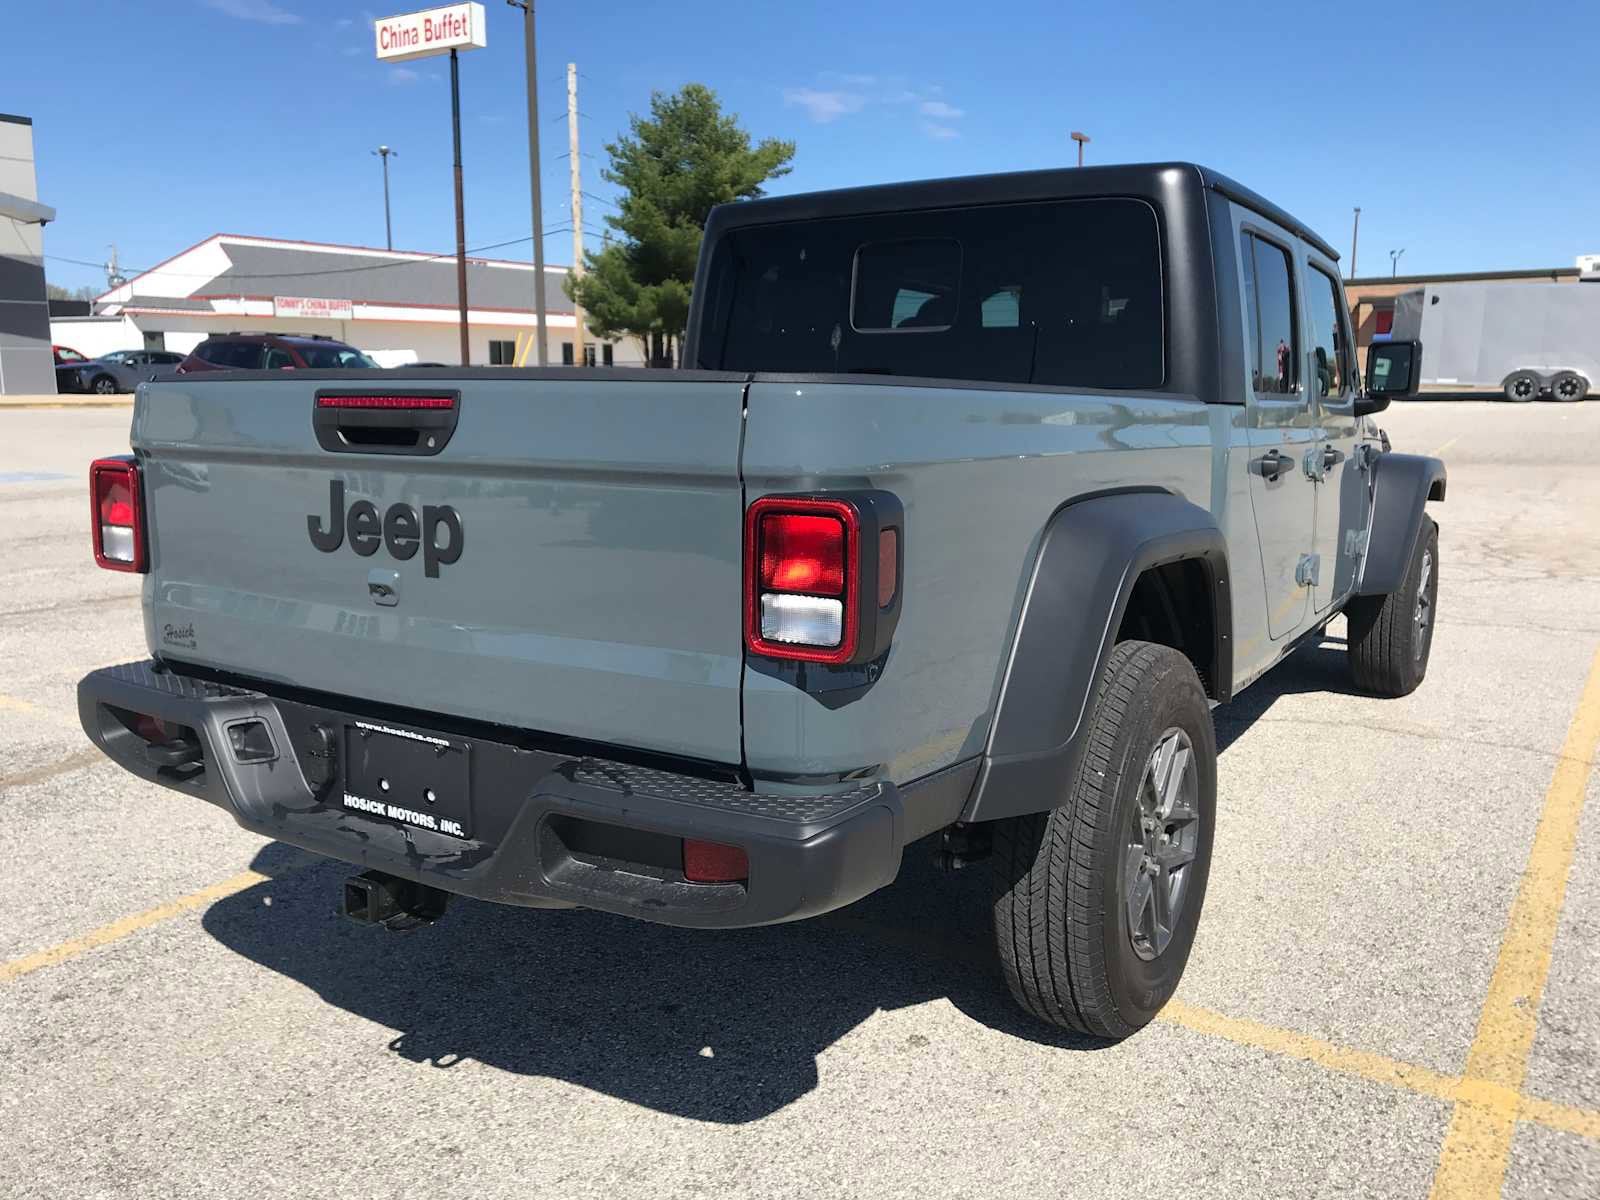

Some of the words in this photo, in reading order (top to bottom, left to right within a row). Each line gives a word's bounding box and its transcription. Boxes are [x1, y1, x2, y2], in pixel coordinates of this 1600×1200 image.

[380, 23, 419, 50] China
[424, 13, 467, 42] Buffet
[306, 299, 327, 310] CHINA
[328, 300, 352, 312] BUFFET
[307, 480, 464, 578] Jeep
[387, 805, 438, 831] MOTORS,
[440, 819, 465, 837] INC.
